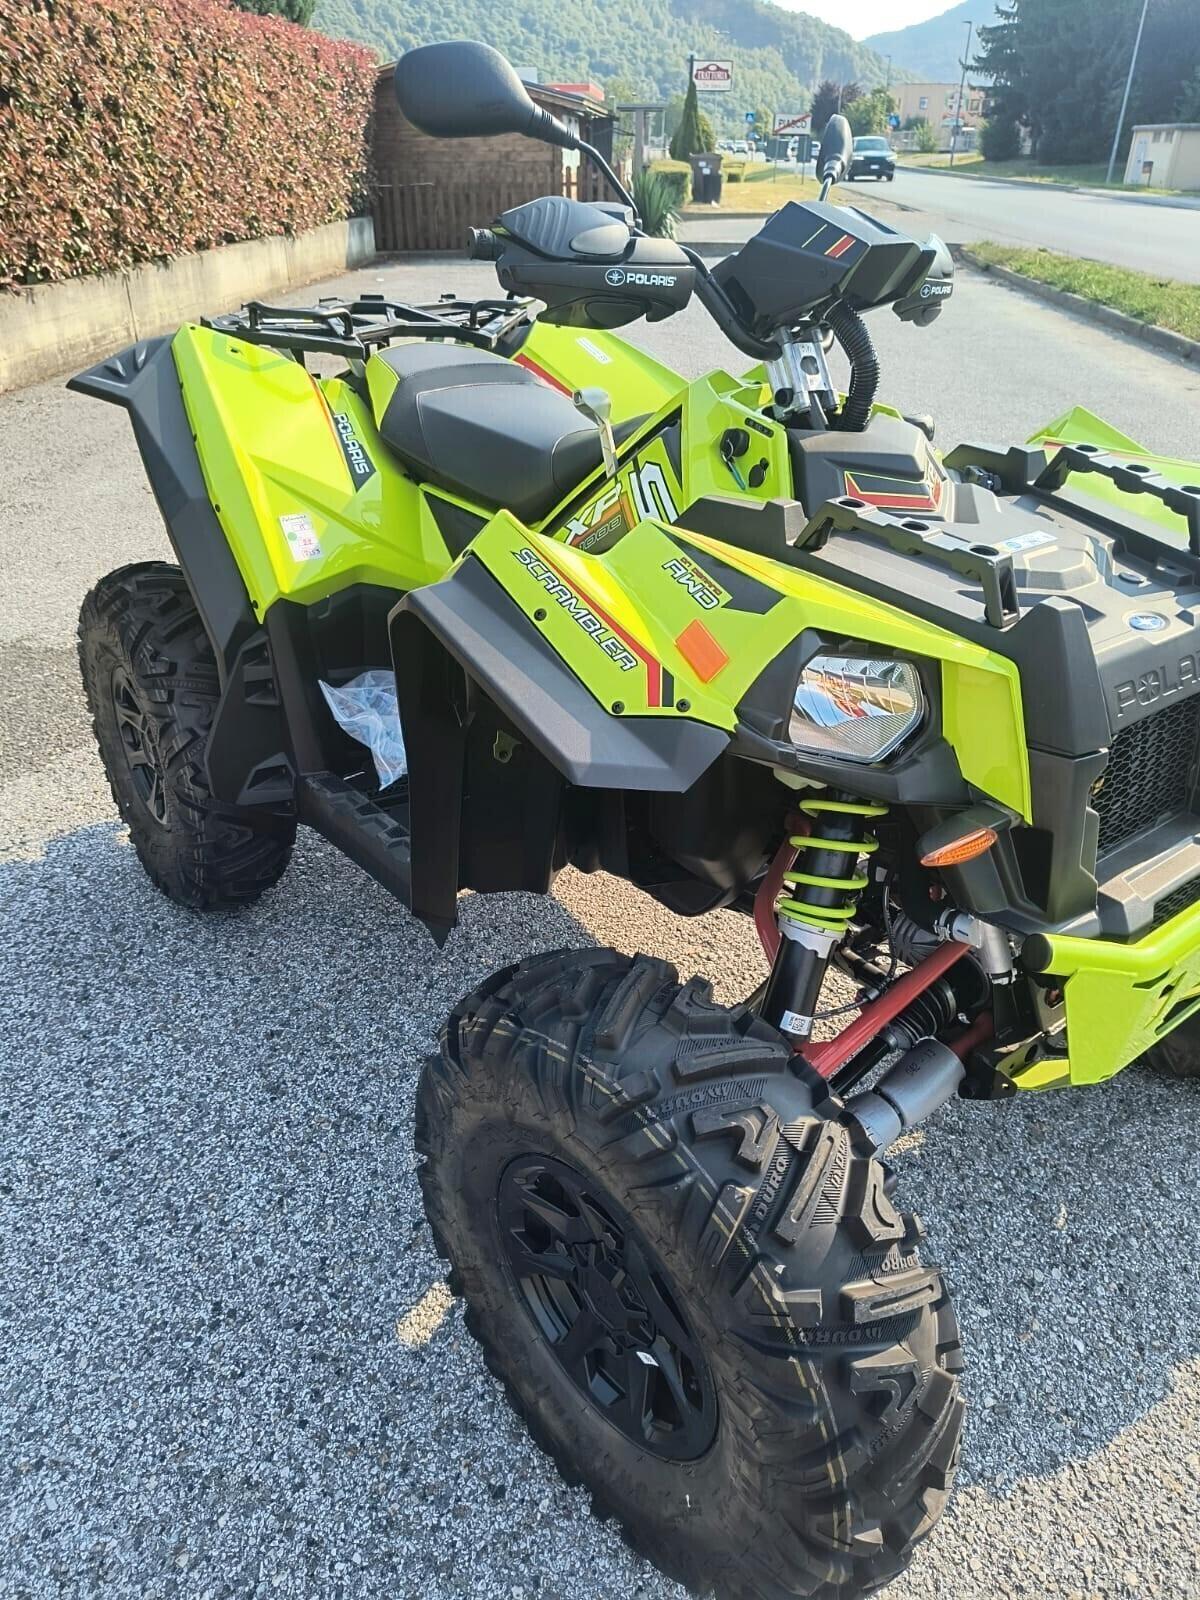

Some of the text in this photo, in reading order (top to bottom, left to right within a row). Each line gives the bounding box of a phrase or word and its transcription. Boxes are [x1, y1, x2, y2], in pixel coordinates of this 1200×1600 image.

[626, 273, 674, 287] POLARIS
[931, 285, 952, 295] POLARIS
[333, 412, 370, 474] POLARIS
[510, 547, 638, 671] SCRAMBLER
[661, 558, 720, 610] AWD
[1112, 650, 1200, 718] POLA
